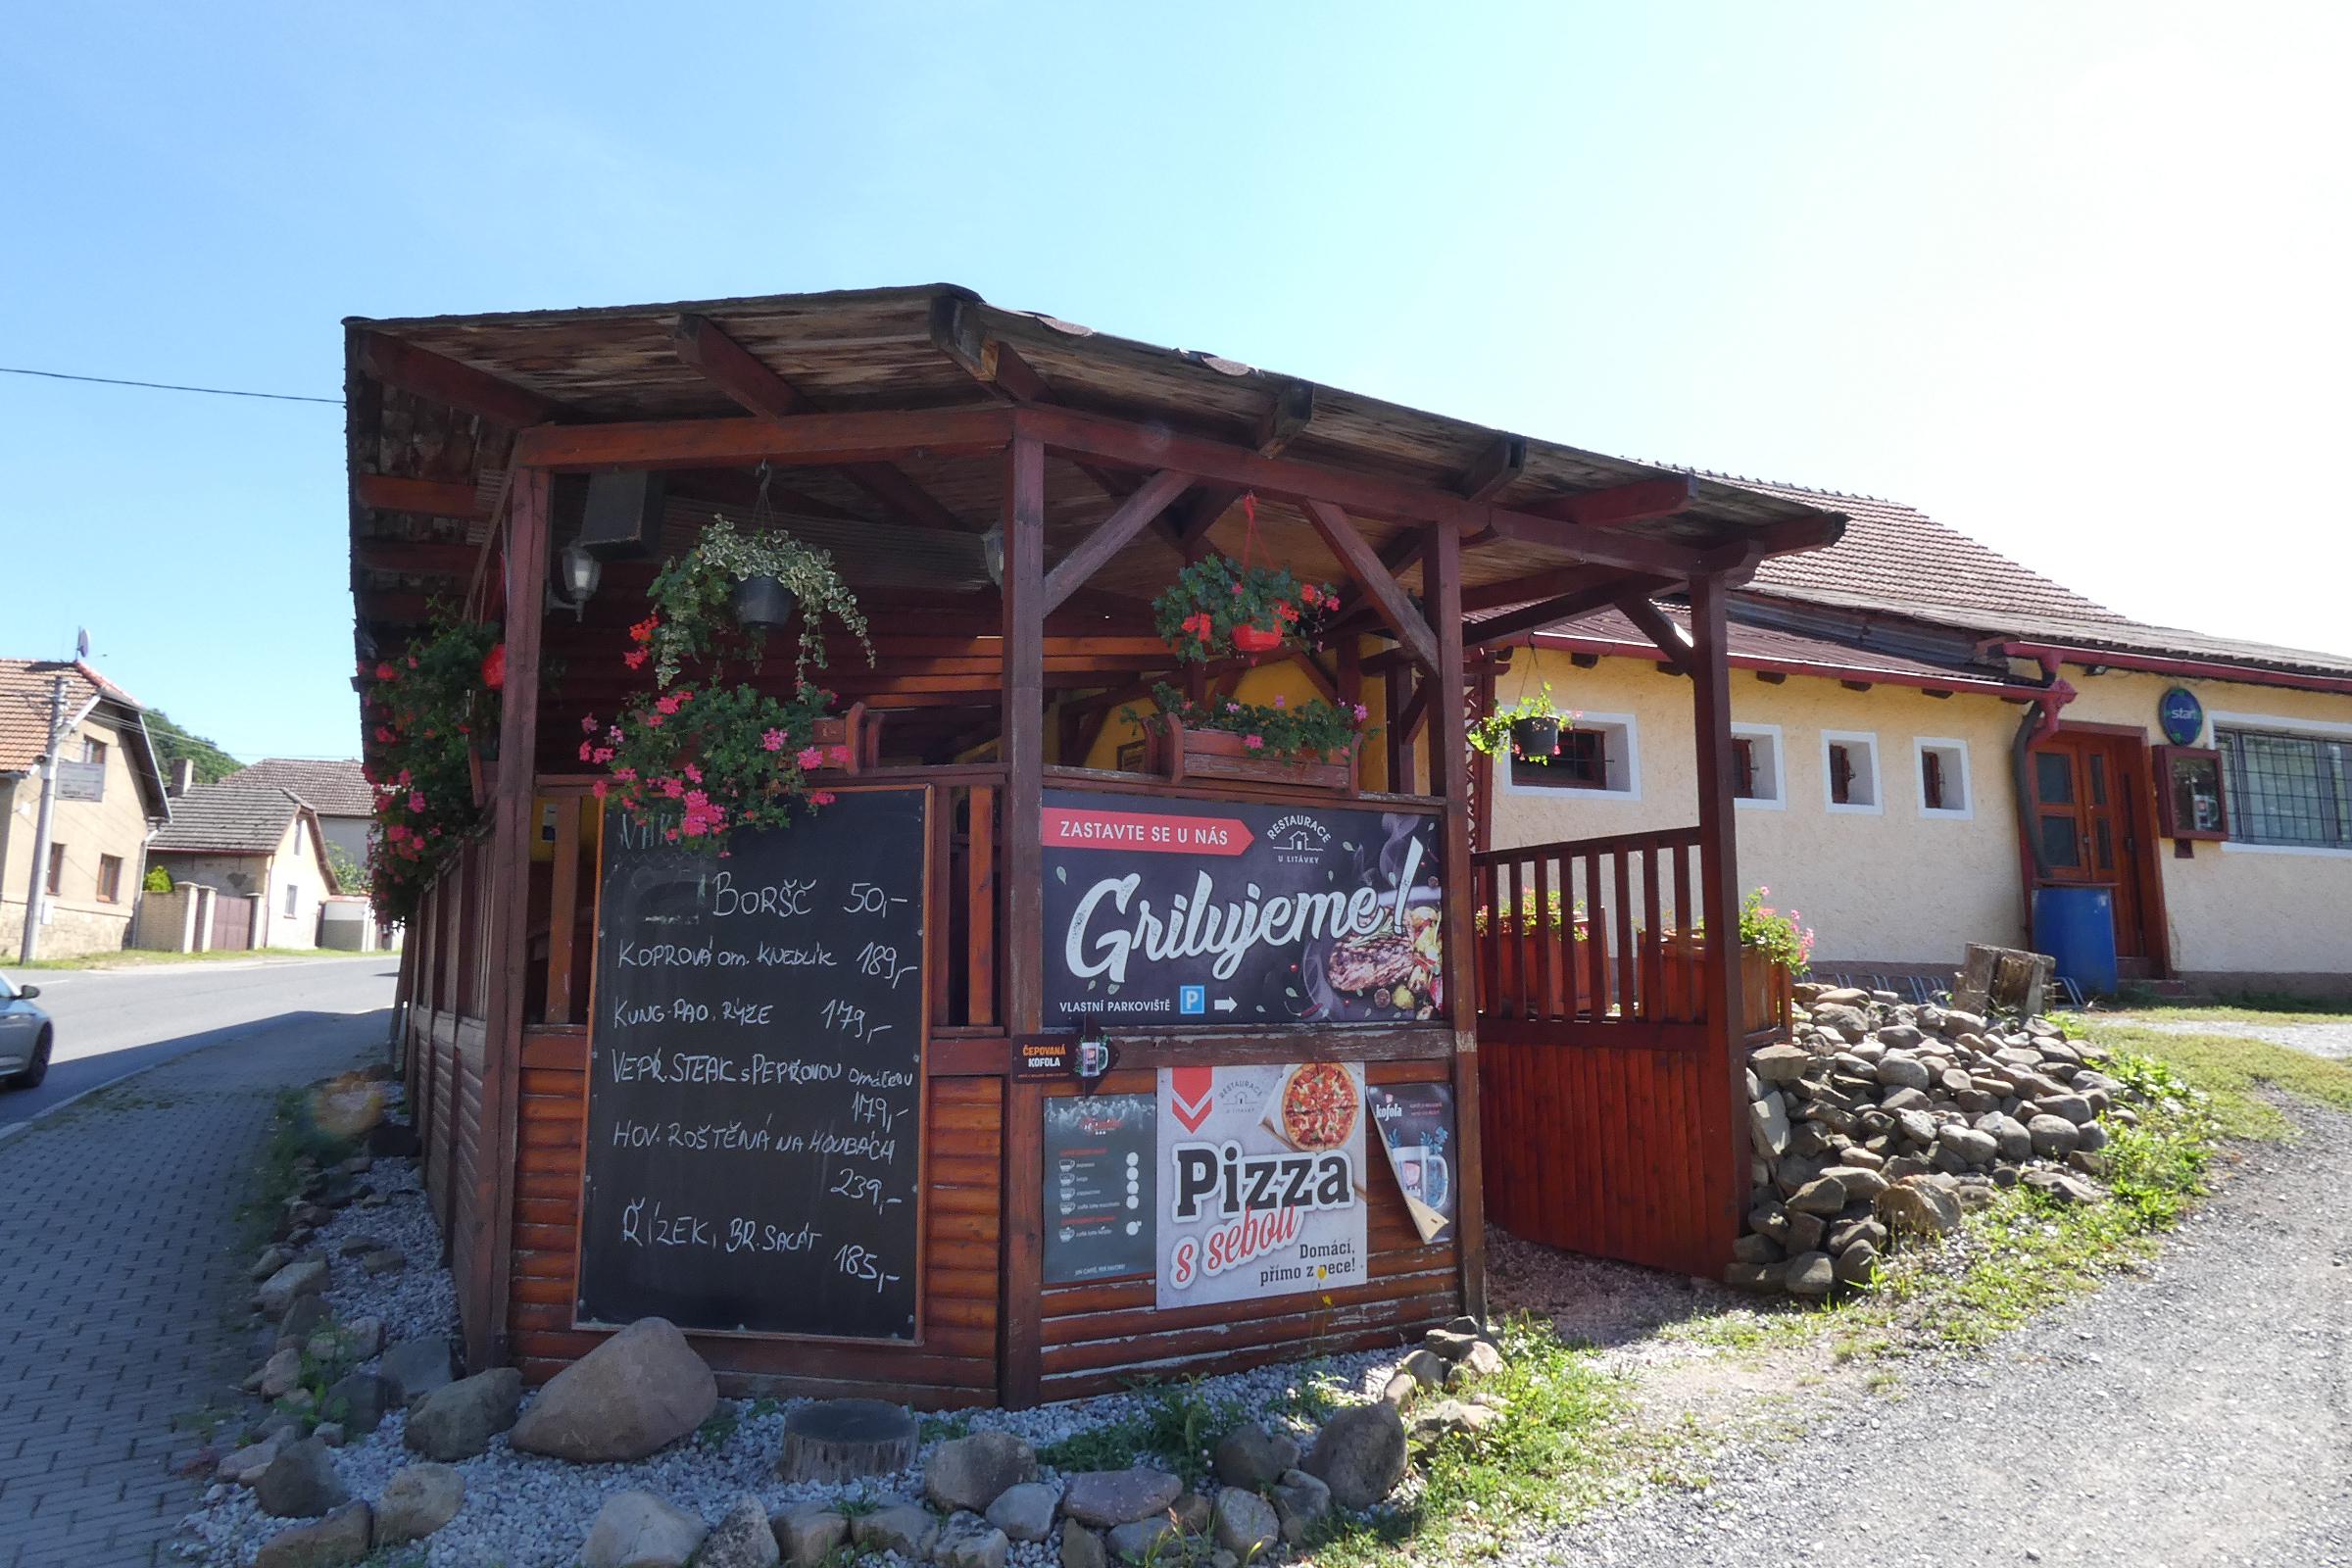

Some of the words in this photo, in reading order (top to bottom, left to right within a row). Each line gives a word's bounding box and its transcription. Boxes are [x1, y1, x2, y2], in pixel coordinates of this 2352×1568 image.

[1060, 821, 1145, 841] ZASTAVTE
[1152, 826, 1170, 842] SE
[1178, 828, 1188, 843] U
[1195, 826, 1229, 845] NÁS
[1267, 815, 1332, 843] RESTAURACE
[1287, 855, 1319, 863] LITÁVKY
[712, 871, 816, 917] BORŠČ
[618, 936, 712, 968] KOPROVÁ
[757, 941, 838, 966] KNEDLÍK
[721, 998, 774, 1026] RÝŽE
[1059, 1000, 1104, 1012] VLASTNÍ
[1107, 999, 1171, 1011] PARKOVIŠTĚ
[1022, 1044, 1066, 1055] ČEPOVANÁ
[1028, 1057, 1060, 1067] KOFOLA
[669, 1053, 736, 1084] STEAK
[1376, 1102, 1402, 1121] kofola
[668, 1113, 772, 1152] ROŠTĚNÁ
[775, 1136, 804, 1152] NA
[809, 1129, 896, 1165] HOUBÁCH
[1177, 1147, 1350, 1217] Pizza
[1176, 1244, 1194, 1283] s
[1207, 1202, 1299, 1270] sebou
[1260, 1264, 1301, 1287] přímo
[1306, 1265, 1314, 1278] z
